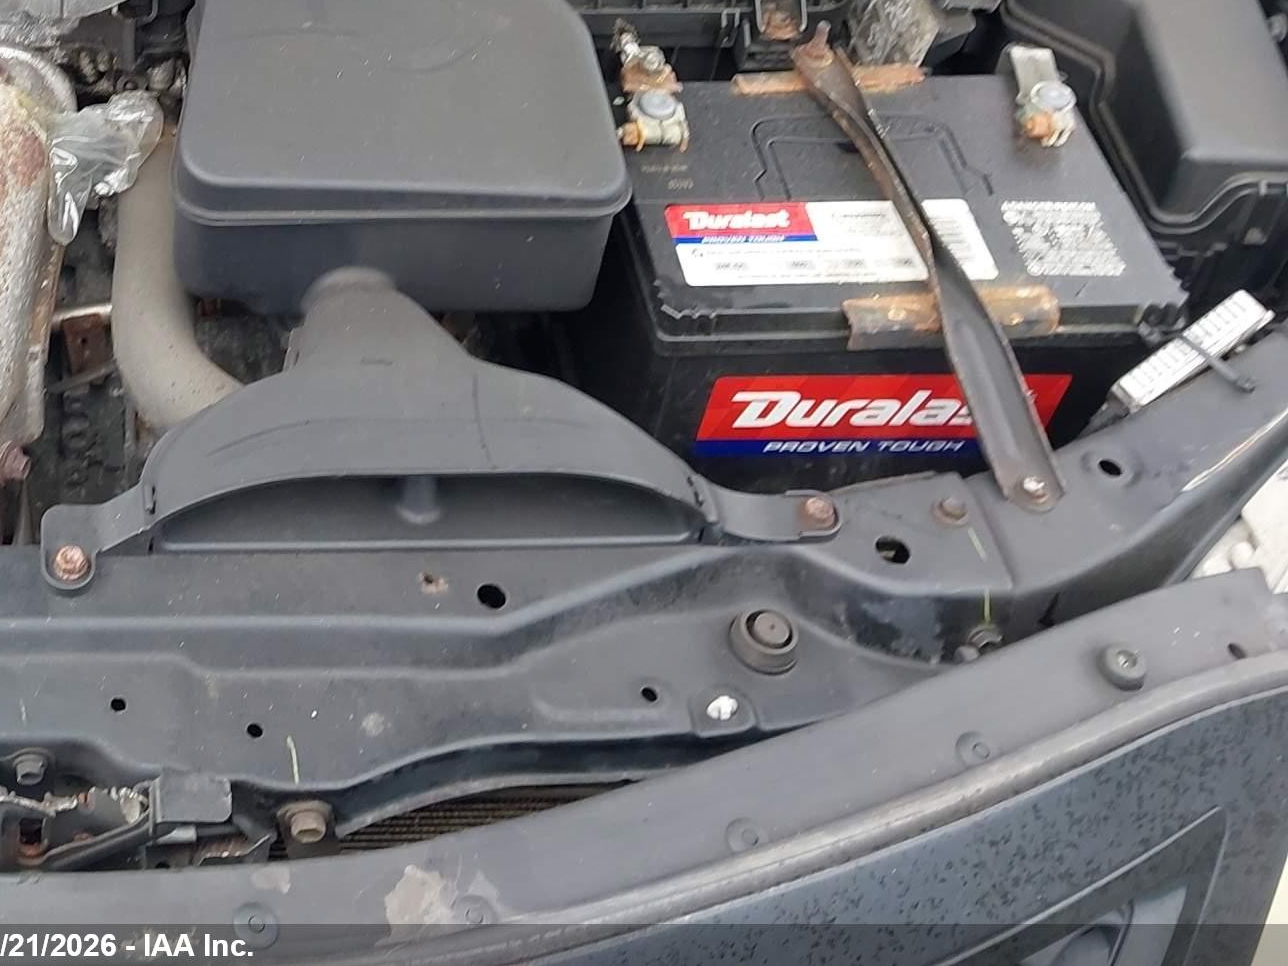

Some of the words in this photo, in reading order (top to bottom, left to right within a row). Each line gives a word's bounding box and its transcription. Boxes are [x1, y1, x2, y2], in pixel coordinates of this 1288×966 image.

[682, 209, 791, 231] Duralast
[763, 441, 868, 454] PROVEN
[878, 440, 965, 453] TOUGH
